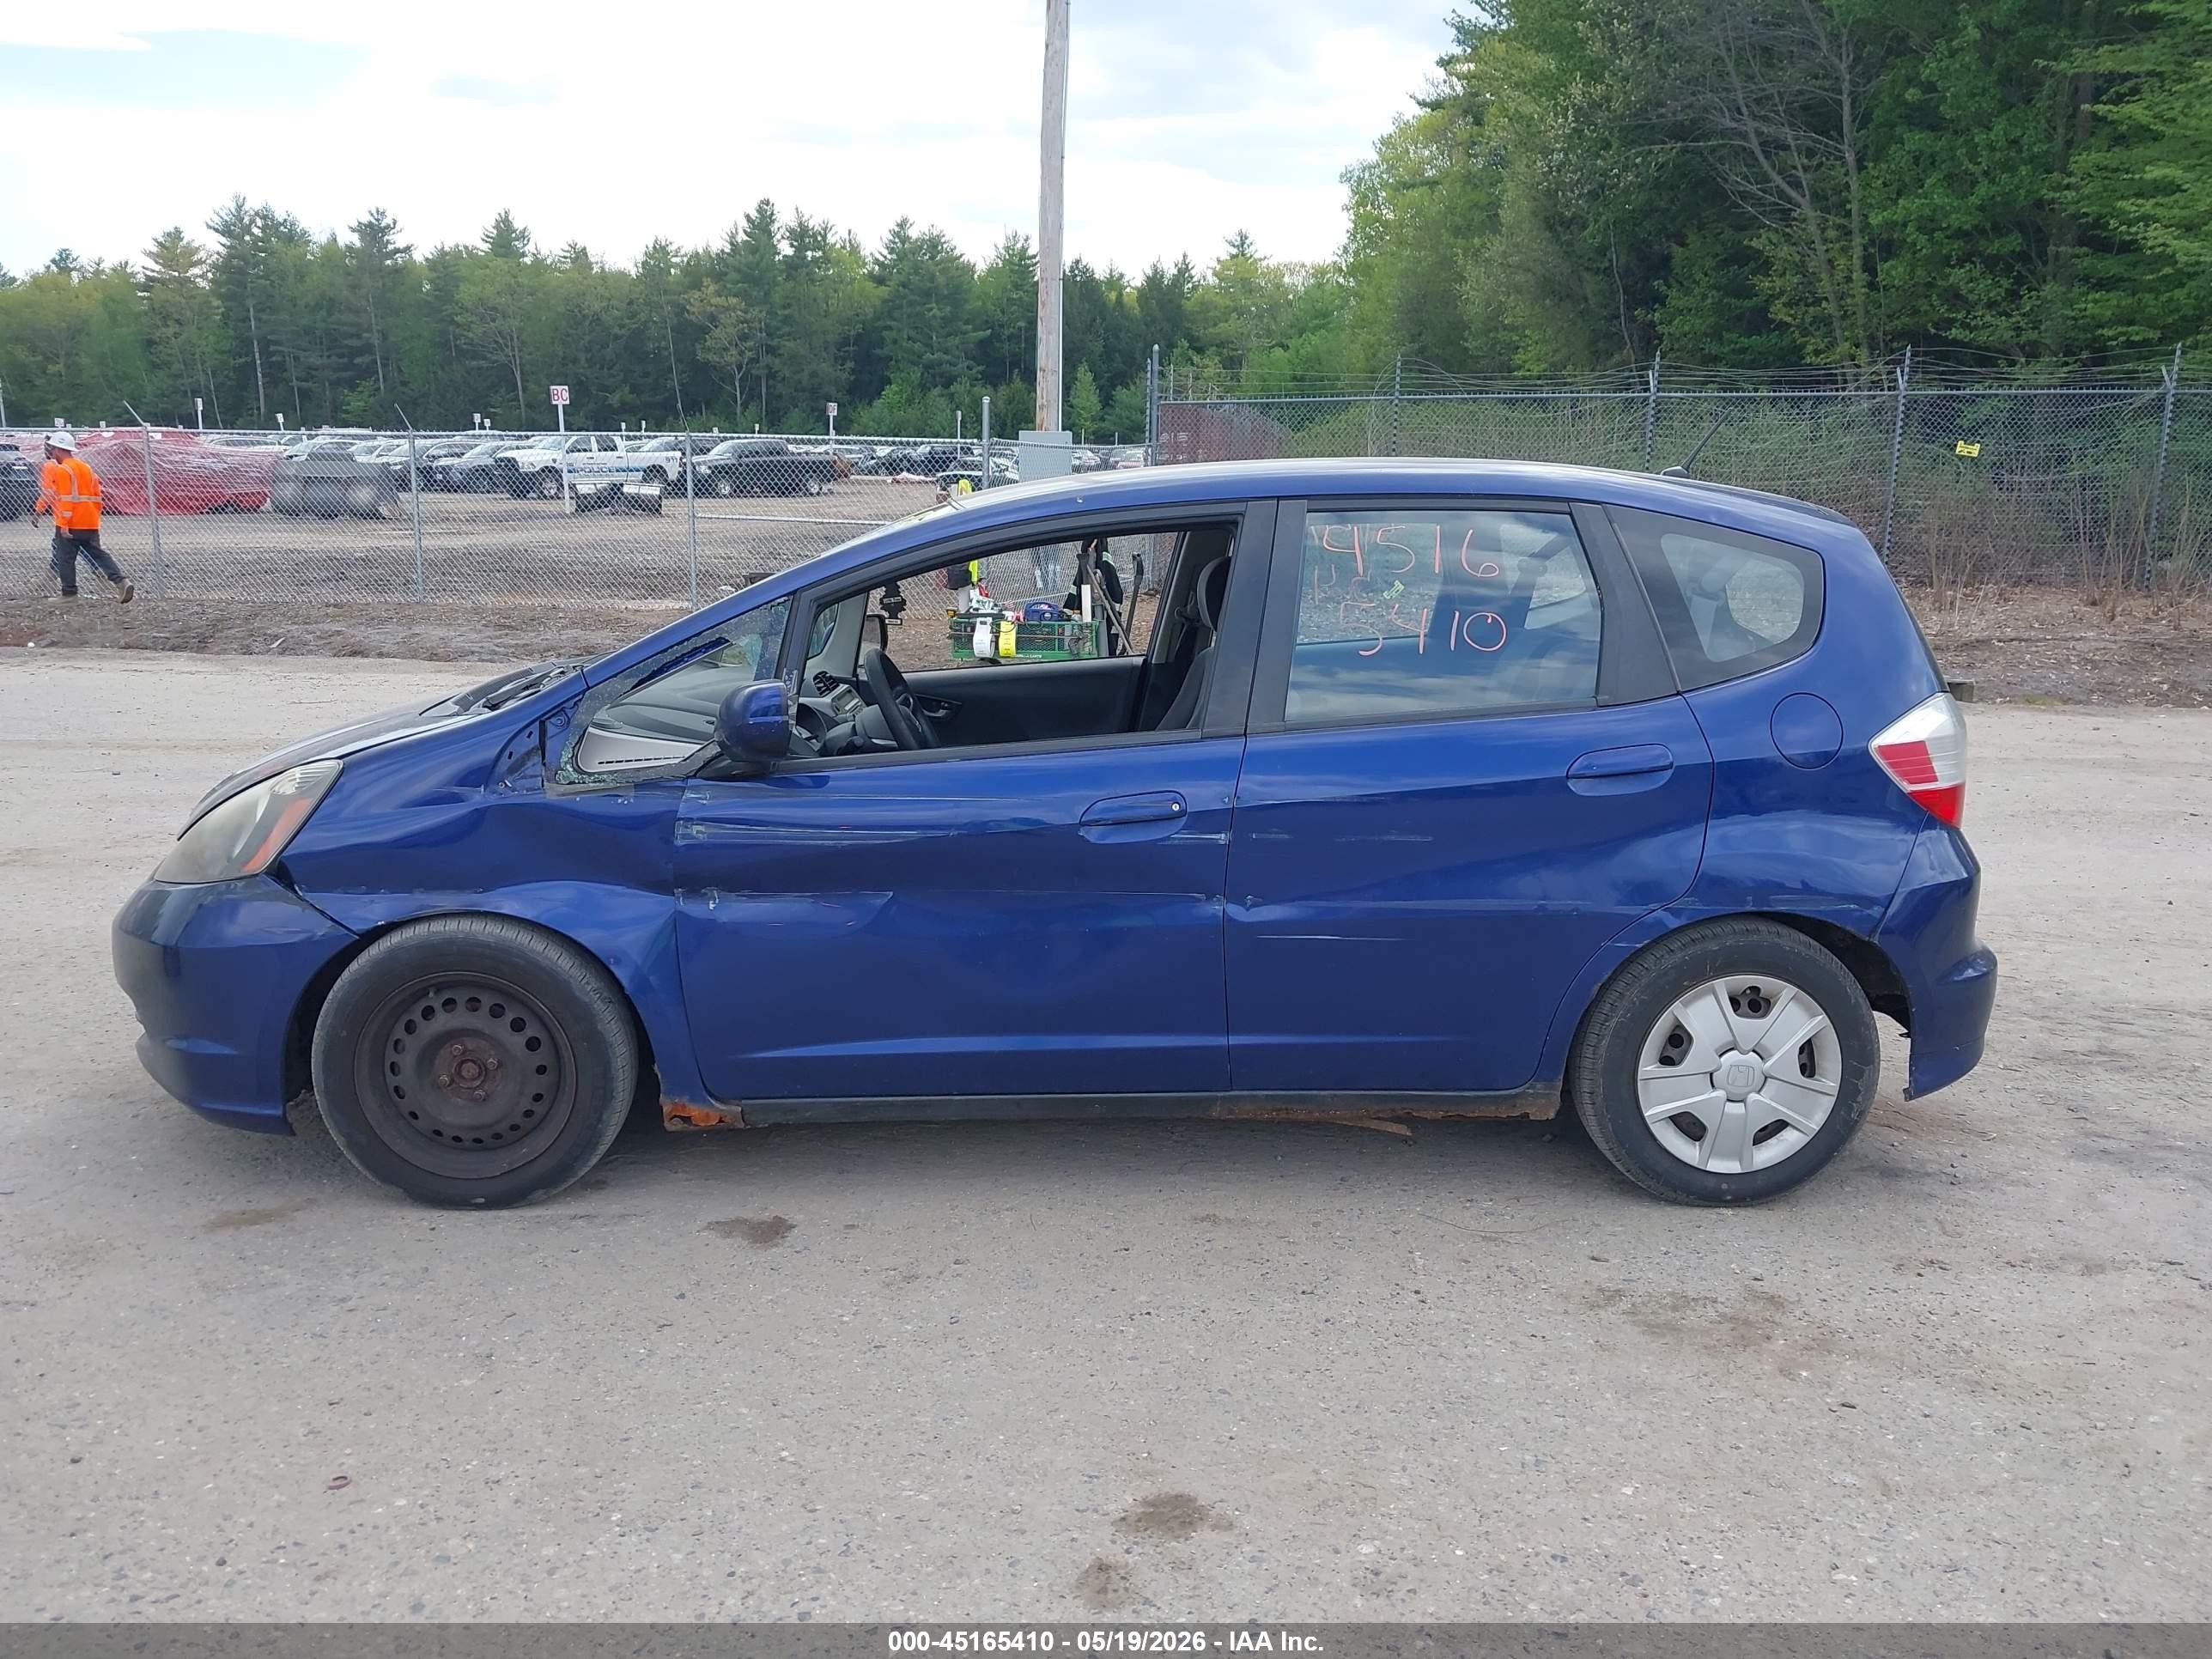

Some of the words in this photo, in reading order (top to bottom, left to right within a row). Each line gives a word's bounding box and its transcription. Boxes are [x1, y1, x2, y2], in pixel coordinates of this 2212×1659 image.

[551, 387, 568, 402] BC
[1323, 525, 1499, 578] 4516
[1340, 601, 1507, 656] 5410
